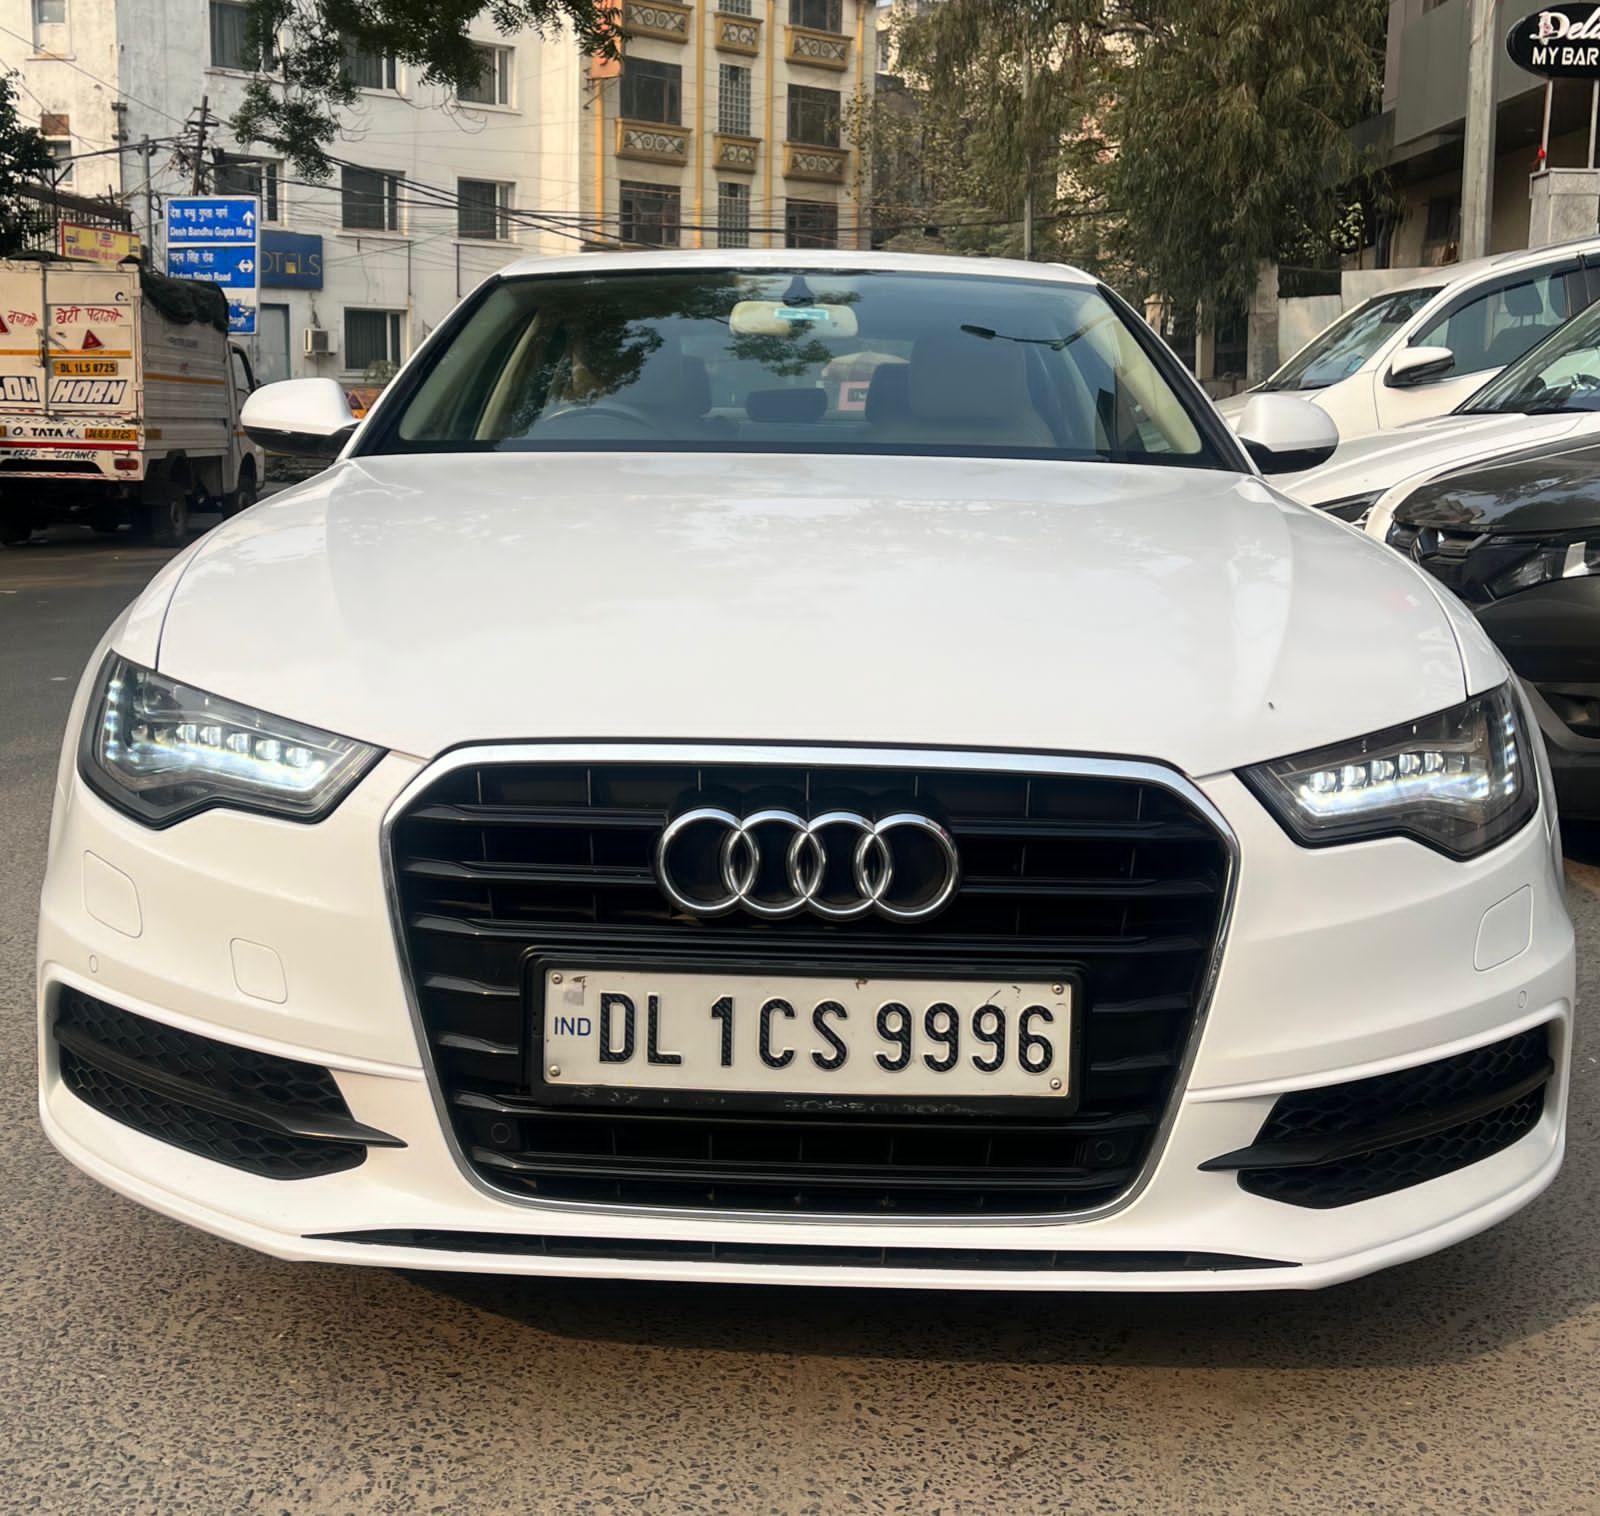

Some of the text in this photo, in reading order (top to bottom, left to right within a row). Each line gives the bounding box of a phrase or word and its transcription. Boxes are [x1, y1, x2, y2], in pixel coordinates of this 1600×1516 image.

[1532, 46, 1600, 65] MY BAR
[169, 227, 253, 239] Desh Bandhu Gupta Marg
[214, 271, 232, 282] Road
[60, 363, 73, 373] DL
[50, 380, 128, 404] HORN
[30, 427, 64, 437] TATA
[554, 1016, 592, 1036] IND
[599, 991, 1055, 1074] DL 1CS 9996
